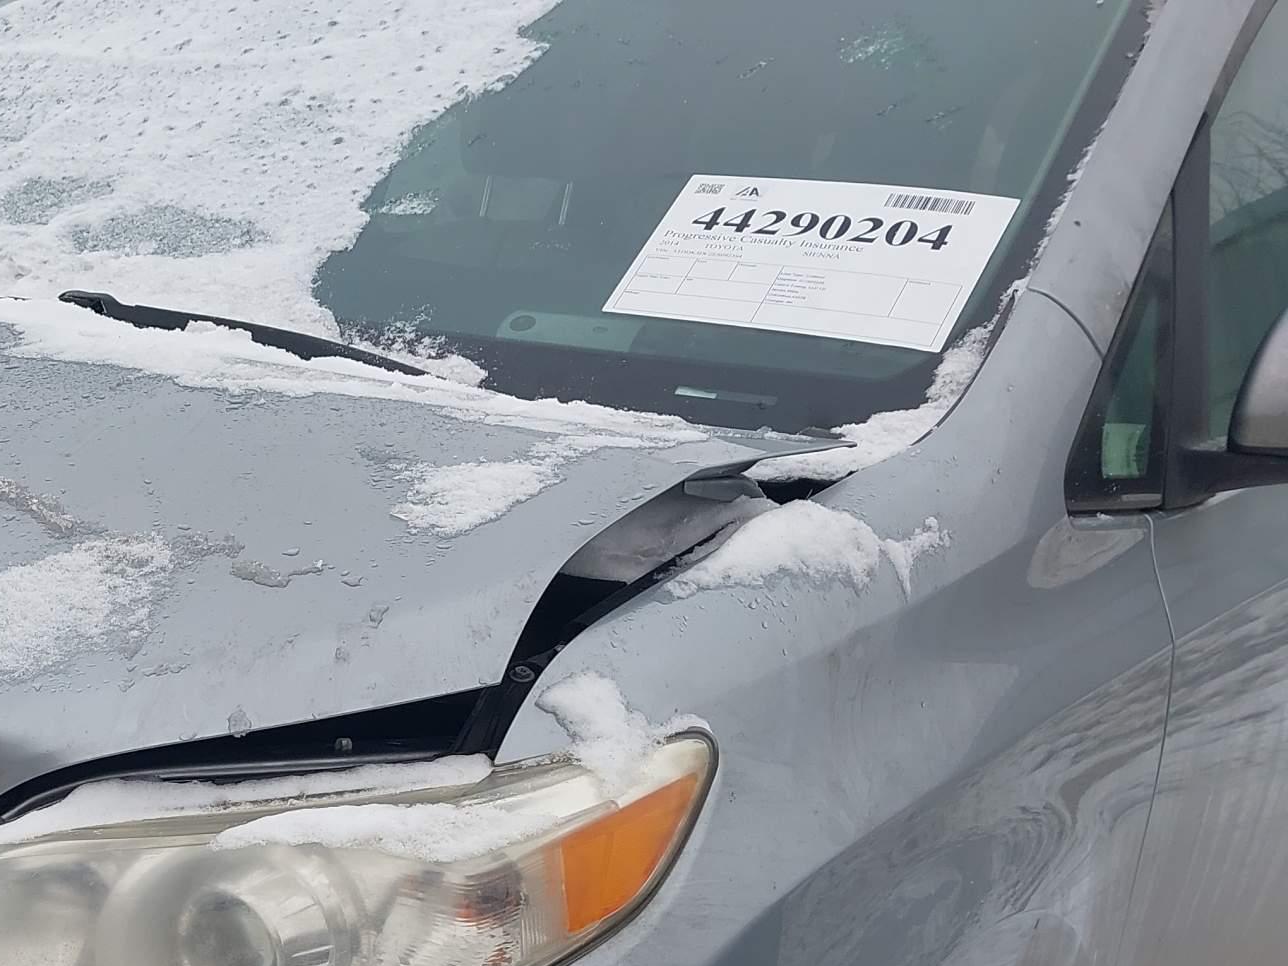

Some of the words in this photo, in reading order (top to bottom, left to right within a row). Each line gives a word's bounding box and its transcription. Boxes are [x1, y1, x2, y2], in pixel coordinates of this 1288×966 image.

[691, 206, 954, 251] 44290204
[664, 230, 737, 242] Progressive
[739, 235, 796, 247] Casualty
[799, 239, 864, 252] Insurance
[705, 243, 744, 251] TOYOTA
[802, 250, 841, 260] SIENNA
